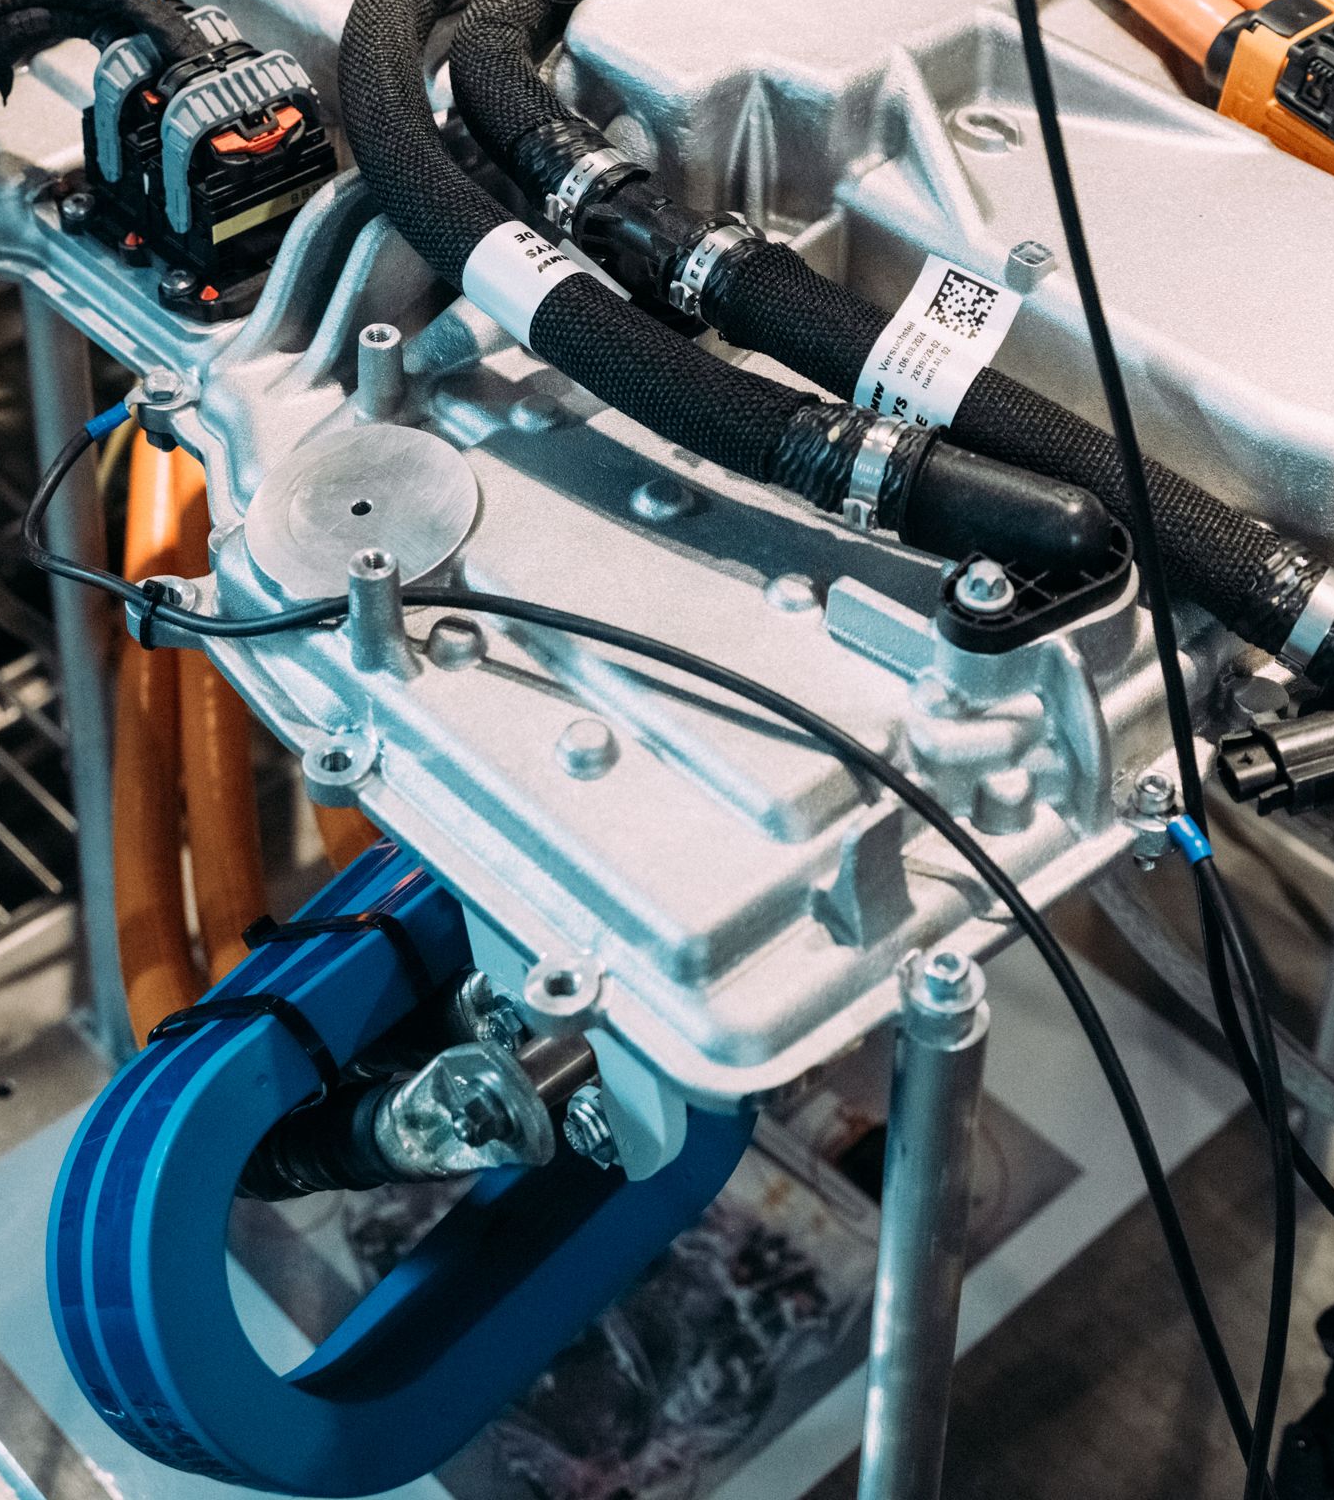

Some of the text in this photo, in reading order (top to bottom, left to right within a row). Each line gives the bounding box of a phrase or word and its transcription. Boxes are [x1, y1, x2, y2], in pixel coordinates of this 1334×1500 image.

[514, 231, 536, 243] DE
[878, 321, 916, 372] Versuchsteil
[921, 367, 937, 389] nach
[870, 381, 885, 412] MW
[892, 397, 908, 418] YS
[915, 414, 928, 427] E
